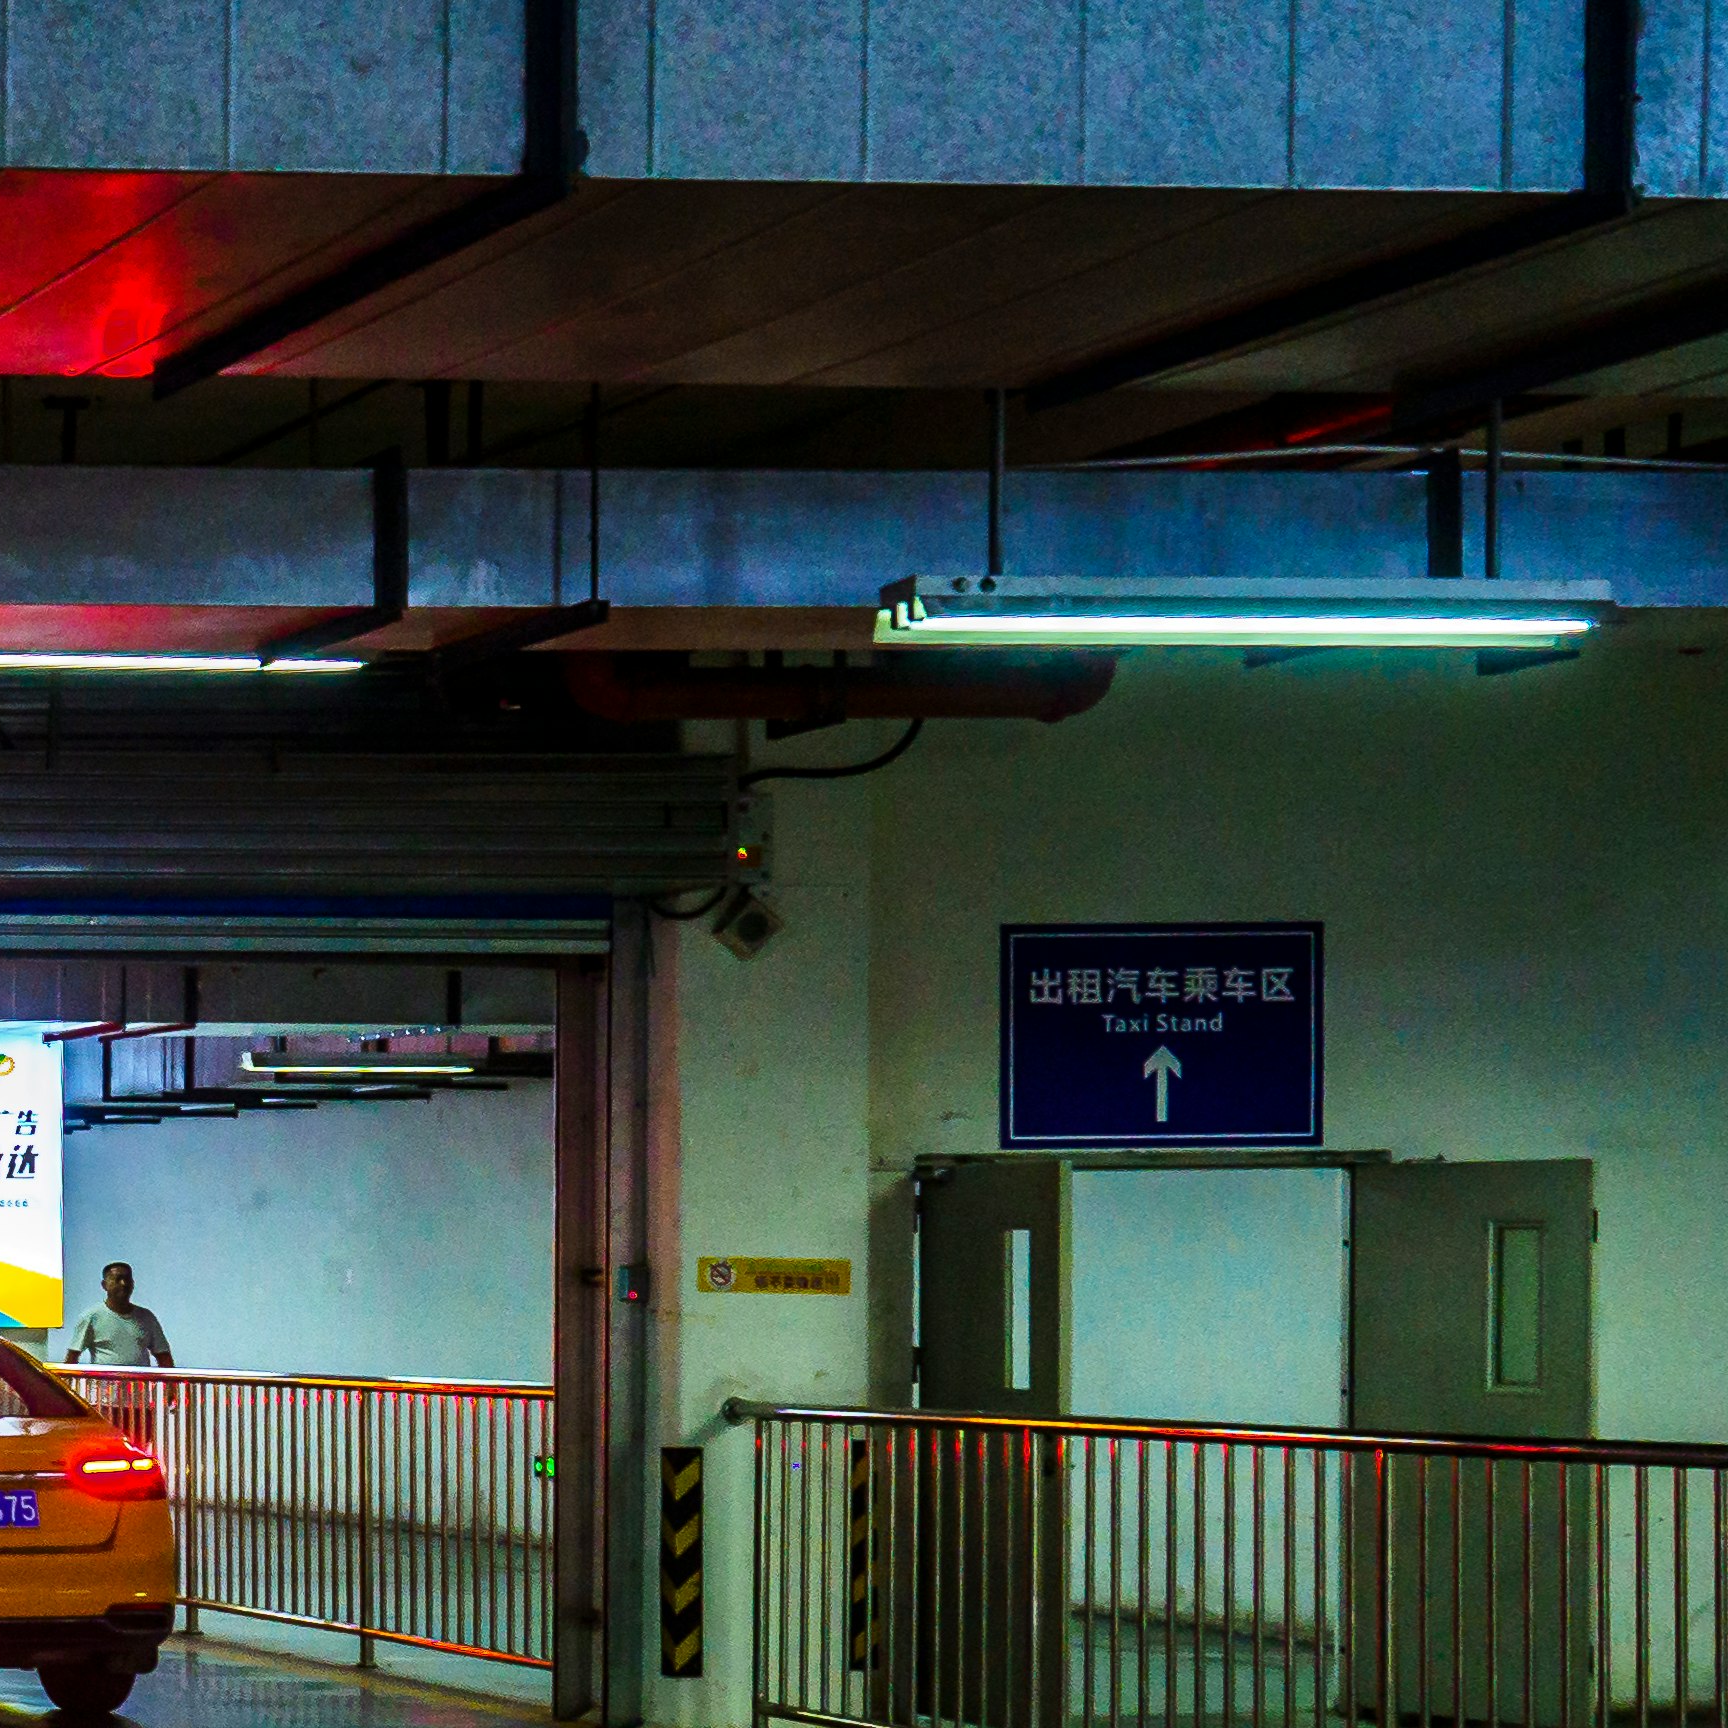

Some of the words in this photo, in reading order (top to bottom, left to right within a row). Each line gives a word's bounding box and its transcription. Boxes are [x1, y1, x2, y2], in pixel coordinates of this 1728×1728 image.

[1030, 967, 1295, 1005] 出租汽车乘车区
[1103, 1014, 1149, 1033] Taxi
[1156, 1012, 1224, 1033] Stand
